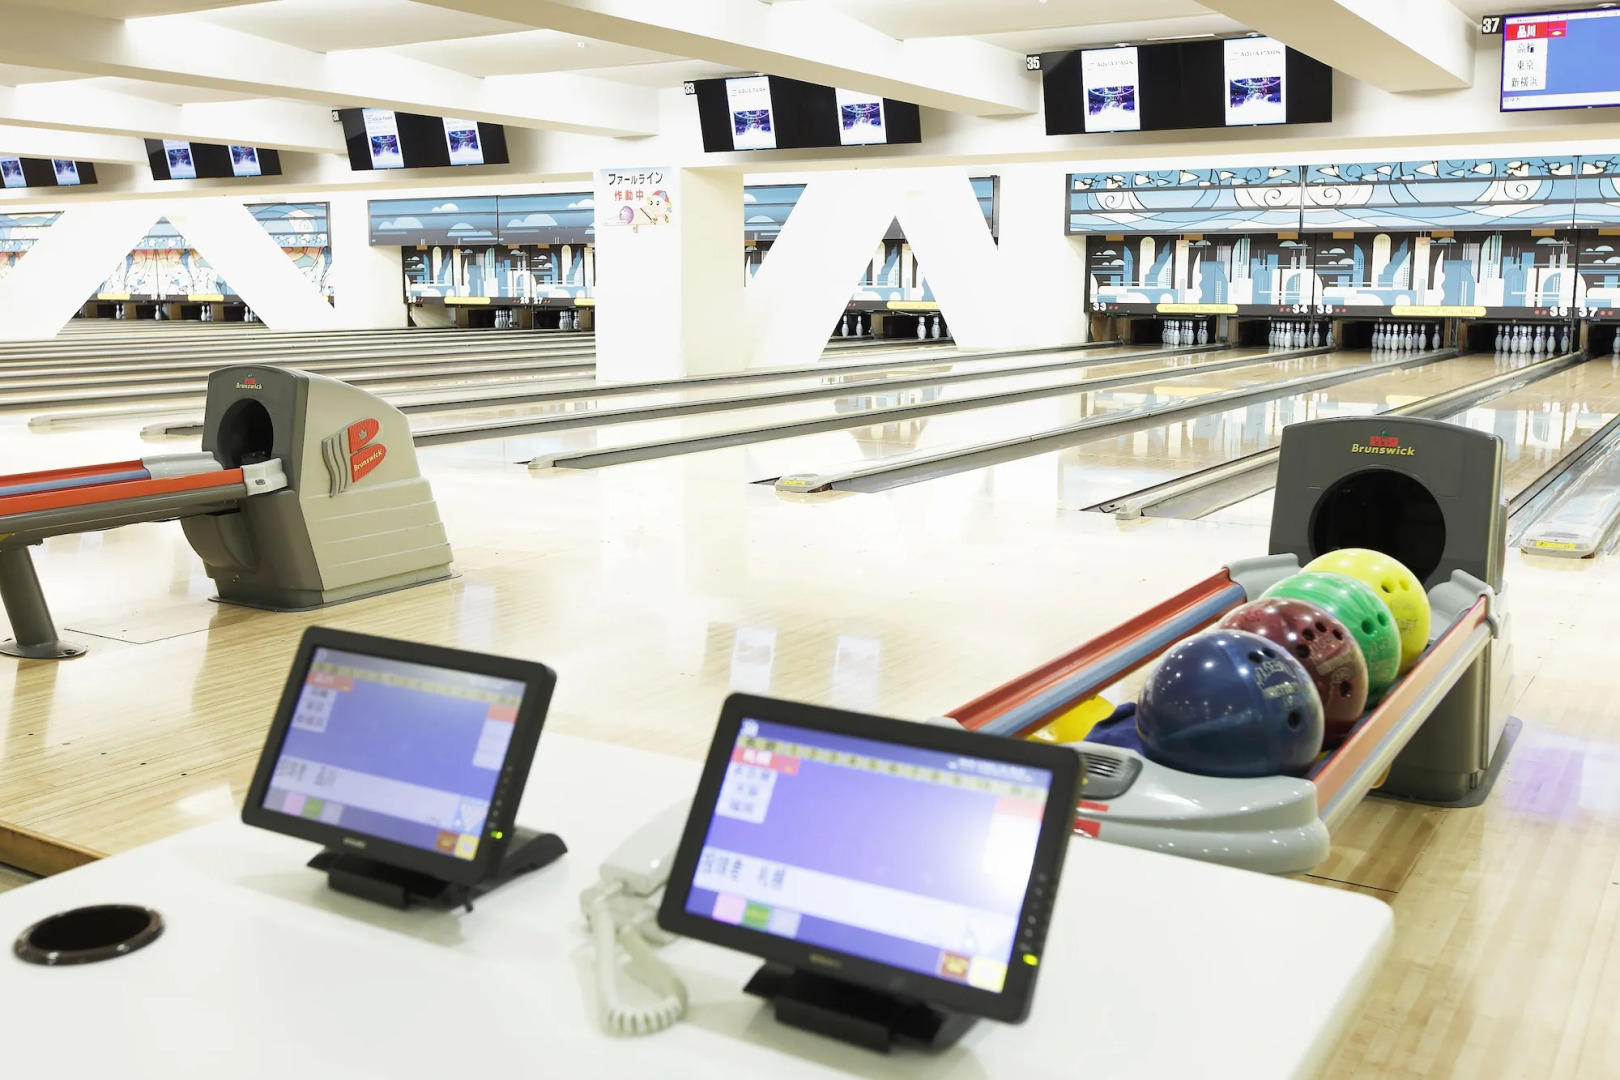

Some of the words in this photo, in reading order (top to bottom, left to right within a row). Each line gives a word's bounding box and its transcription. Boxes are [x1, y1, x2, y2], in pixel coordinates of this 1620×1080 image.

[1482, 18, 1500, 33] 37
[1517, 24, 1536, 38] 品川
[1027, 56, 1040, 69] 35
[1517, 60, 1534, 70] 東京
[685, 82, 695, 94] 33
[608, 172, 663, 185] ファールライン
[614, 189, 643, 201] 作動中
[1093, 302, 1106, 311] 33
[1292, 304, 1308, 314] 34
[1579, 306, 1598, 317] 37
[236, 382, 263, 390] Brunswick
[1351, 443, 1416, 456] Brunswick
[353, 449, 383, 471] Brunswick
